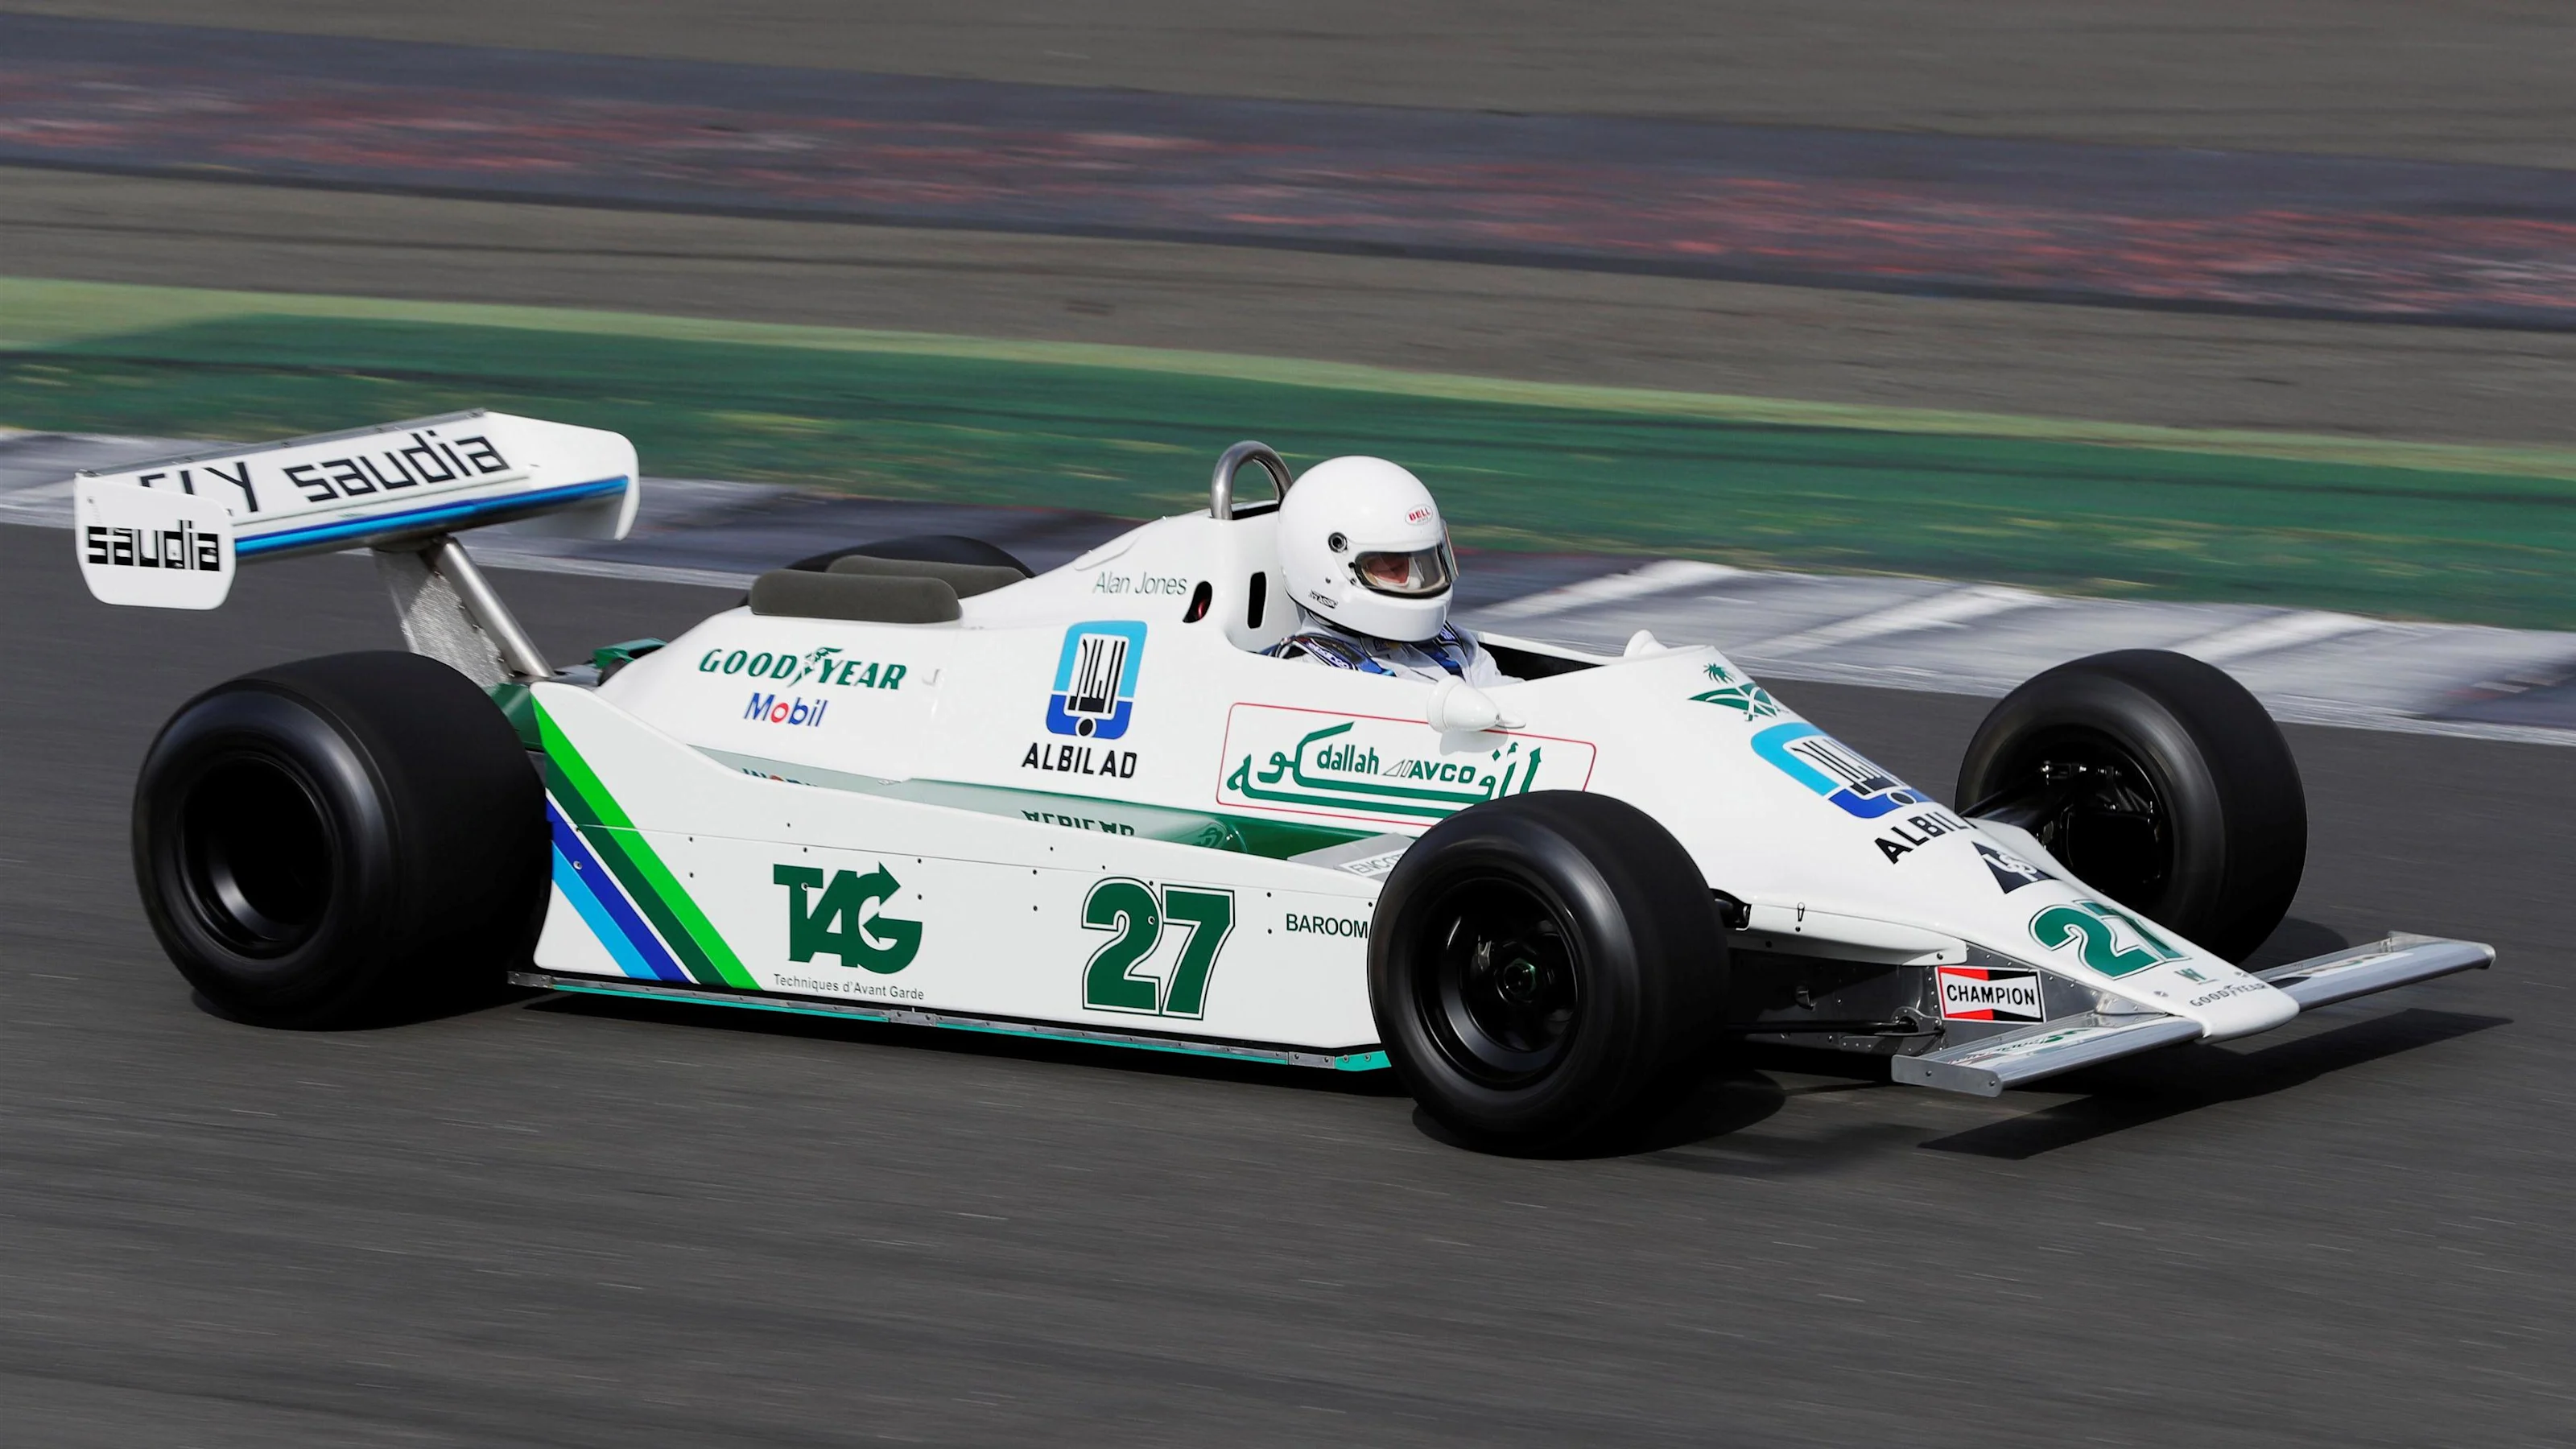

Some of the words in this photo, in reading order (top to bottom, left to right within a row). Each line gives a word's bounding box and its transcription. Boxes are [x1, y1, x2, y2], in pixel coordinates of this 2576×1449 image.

[283, 430, 511, 503] saudia
[1409, 506, 1431, 522] BELL
[86, 519, 221, 572] saudia
[1092, 571, 1131, 595] Alan
[1134, 572, 1187, 597] Jones
[699, 646, 908, 691] GOODYEAR
[743, 692, 829, 728] Mobil
[1022, 742, 1138, 779] ALBILAD
[1316, 744, 1380, 776] dallah
[1408, 760, 1477, 784] AVCO
[1874, 811, 1971, 865] ALBIL
[774, 861, 923, 974] TAG
[1286, 913, 1368, 939] BAROOM
[1081, 877, 1235, 1021] 27
[2029, 898, 2192, 980] 27
[774, 973, 839, 992] Techniques
[843, 980, 886, 997] d'Avant
[890, 985, 924, 1000] Garde
[1946, 983, 2036, 1006] CHAMPION
